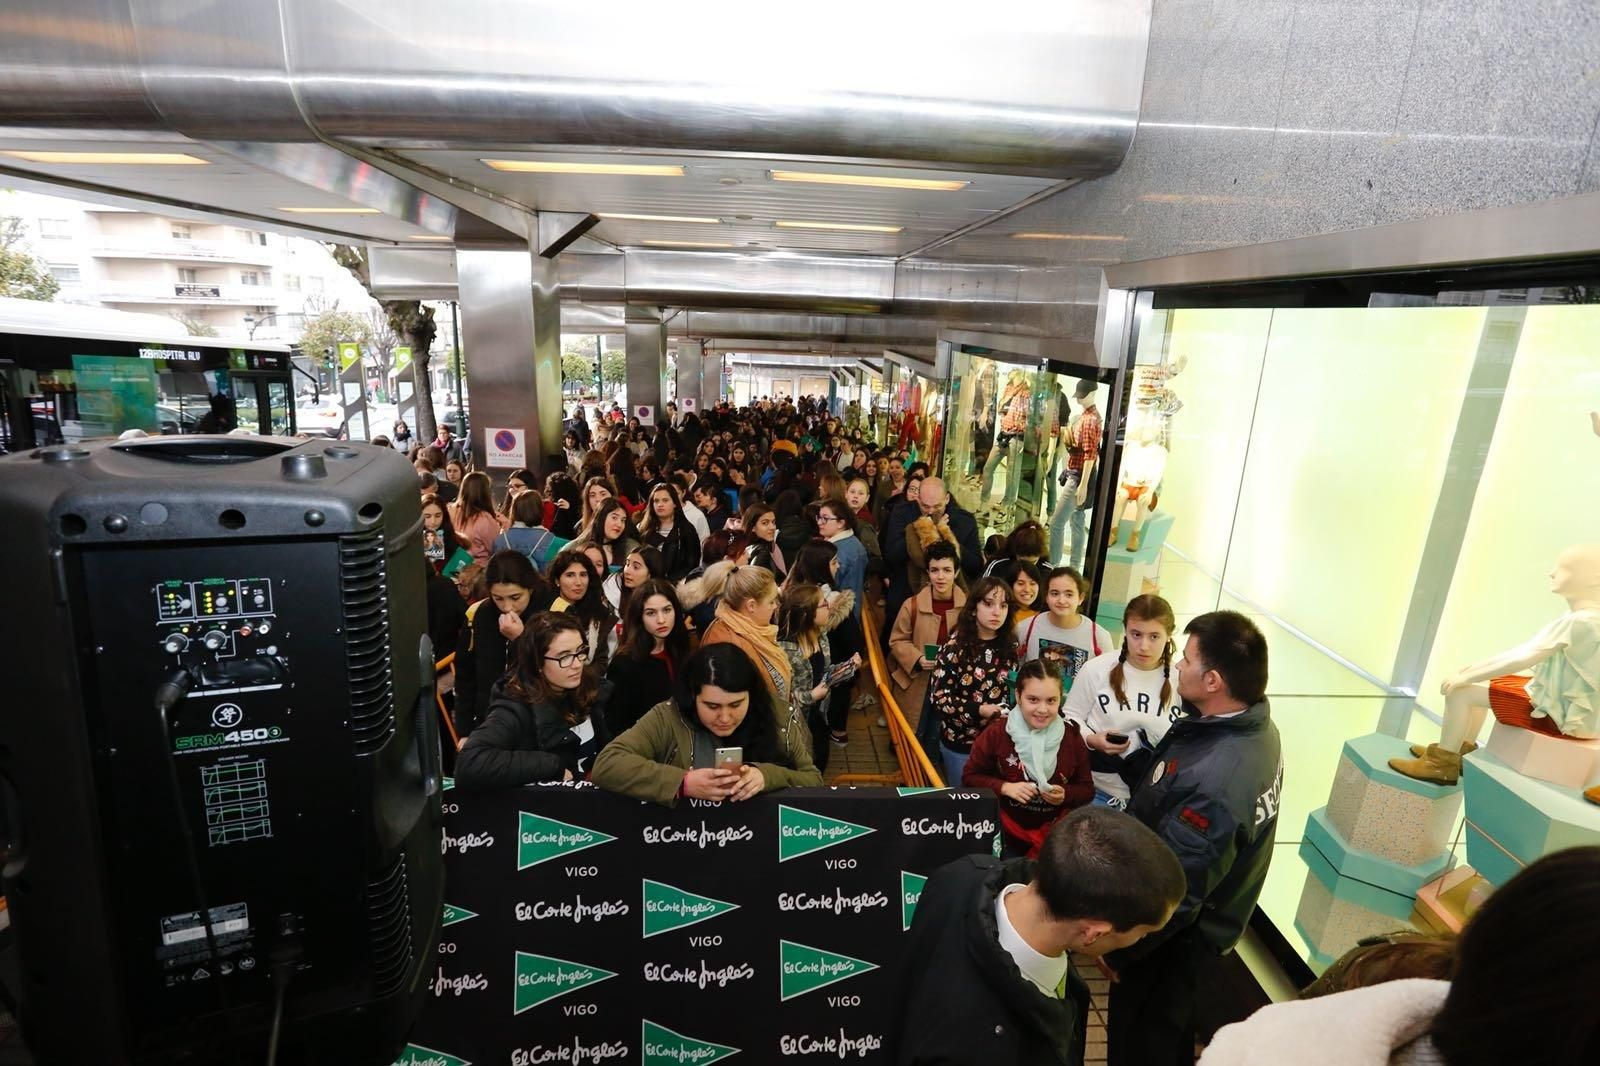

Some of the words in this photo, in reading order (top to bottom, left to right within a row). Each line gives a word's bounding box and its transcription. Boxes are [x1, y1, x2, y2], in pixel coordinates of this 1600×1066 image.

[154, 349, 187, 360] HOSPITAL
[1098, 693, 1181, 723] PARIS
[442, 803, 459, 813] GO
[689, 798, 722, 807] VIGO
[643, 827, 659, 843] El
[661, 827, 697, 842] Corte
[699, 821, 753, 848] Inglés
[782, 826, 792, 836] El
[792, 826, 817, 836] Corte
[818, 823, 852, 840] Inglés
[902, 819, 917, 835] El
[919, 820, 954, 835] Corte
[442, 827, 494, 854] Inglés
[522, 833, 532, 843] El
[533, 833, 557, 843] Corte
[558, 827, 593, 846] Inglés
[565, 867, 598, 876] VIGO
[825, 859, 857, 869] VIGO
[515, 903, 531, 921] El
[533, 902, 572, 919] Corte
[574, 895, 629, 923] Inglés
[646, 901, 656, 911] El
[656, 901, 680, 912] Corte
[682, 897, 715, 916] Inglés
[778, 893, 794, 910] El
[796, 893, 832, 910] Corte
[835, 887, 888, 914] Inglés
[439, 943, 456, 953] GO
[690, 936, 722, 947] VIGO
[644, 963, 660, 981] El
[661, 964, 697, 982] Corte
[699, 960, 754, 989] Inglés
[784, 962, 794, 973] El
[795, 962, 819, 973] Corte
[820, 958, 854, 976] Inglés
[436, 967, 488, 996] Inglés
[518, 974, 529, 986] El
[530, 974, 555, 984] Corte
[557, 968, 593, 986] Inglés
[564, 1004, 597, 1016] VIGO
[828, 996, 860, 1007] VIGO
[511, 1049, 529, 1066] El
[530, 1046, 570, 1064] Corte
[571, 1036, 628, 1066] Inglés
[646, 1044, 655, 1055] El
[656, 1045, 678, 1057] Corte
[780, 1035, 797, 1055] El
[798, 1035, 836, 1054] Corte
